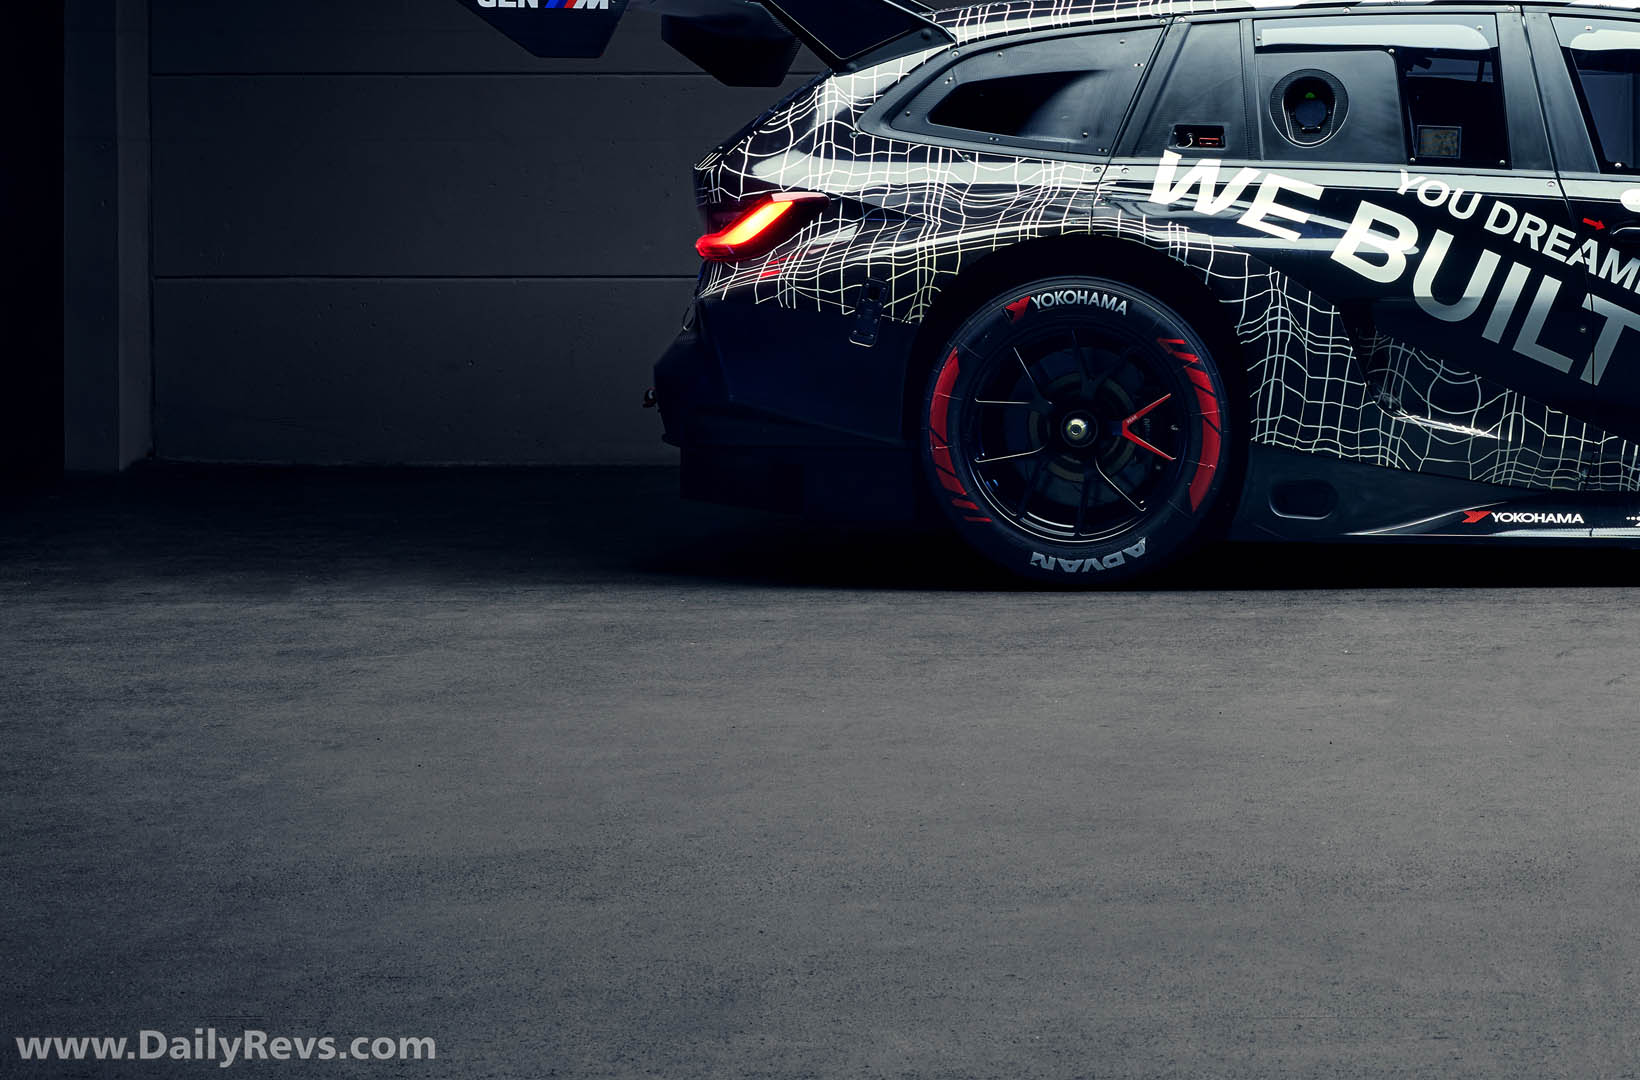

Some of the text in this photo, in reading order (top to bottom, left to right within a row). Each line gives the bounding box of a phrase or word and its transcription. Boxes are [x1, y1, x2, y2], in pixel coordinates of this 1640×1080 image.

[1148, 149, 1325, 243] WE
[1396, 169, 1483, 220] YOU
[1030, 289, 1128, 316] YOKOHAMA
[1491, 512, 1585, 524] YOKOHAMA
[1030, 536, 1148, 573] ADVAN
